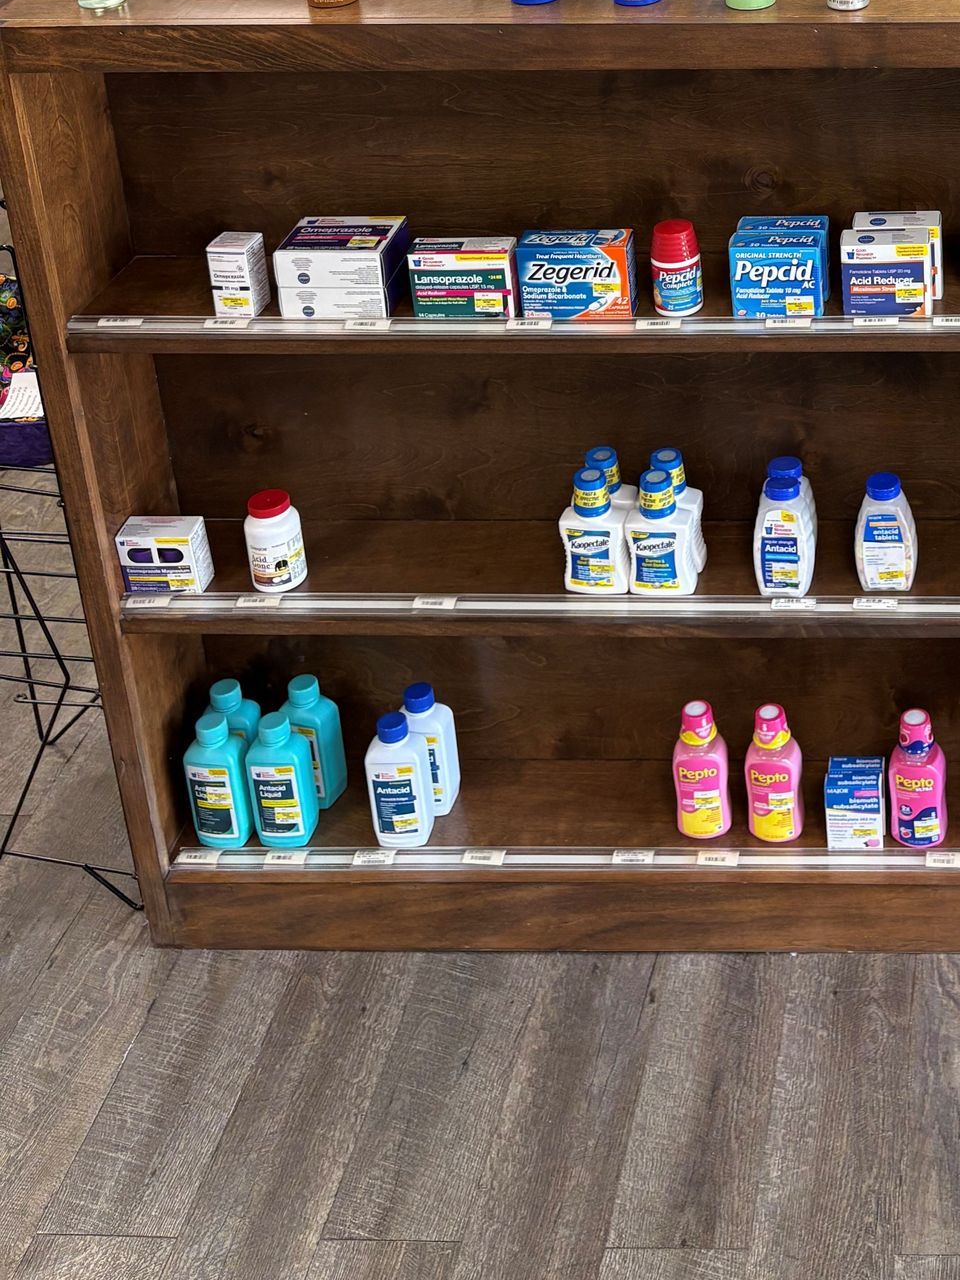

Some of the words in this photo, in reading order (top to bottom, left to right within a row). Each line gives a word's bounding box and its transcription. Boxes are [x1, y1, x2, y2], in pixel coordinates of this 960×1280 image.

[528, 262, 615, 284] Zegerid
[660, 270, 696, 282] Pepcid
[734, 260, 814, 283] Pepcid
[414, 274, 482, 283] Lansoprazole
[850, 276, 871, 284] Acid
[874, 276, 914, 285] Reducer
[802, 281, 815, 289] AC
[571, 539, 609, 549] Kaopectate
[636, 541, 674, 552] Kaopectate
[765, 544, 796, 553] Antacid
[679, 766, 717, 782] Pepto
[750, 770, 788, 784] Pepto
[896, 774, 934, 789] Pepto
[376, 786, 410, 794] Antacid
